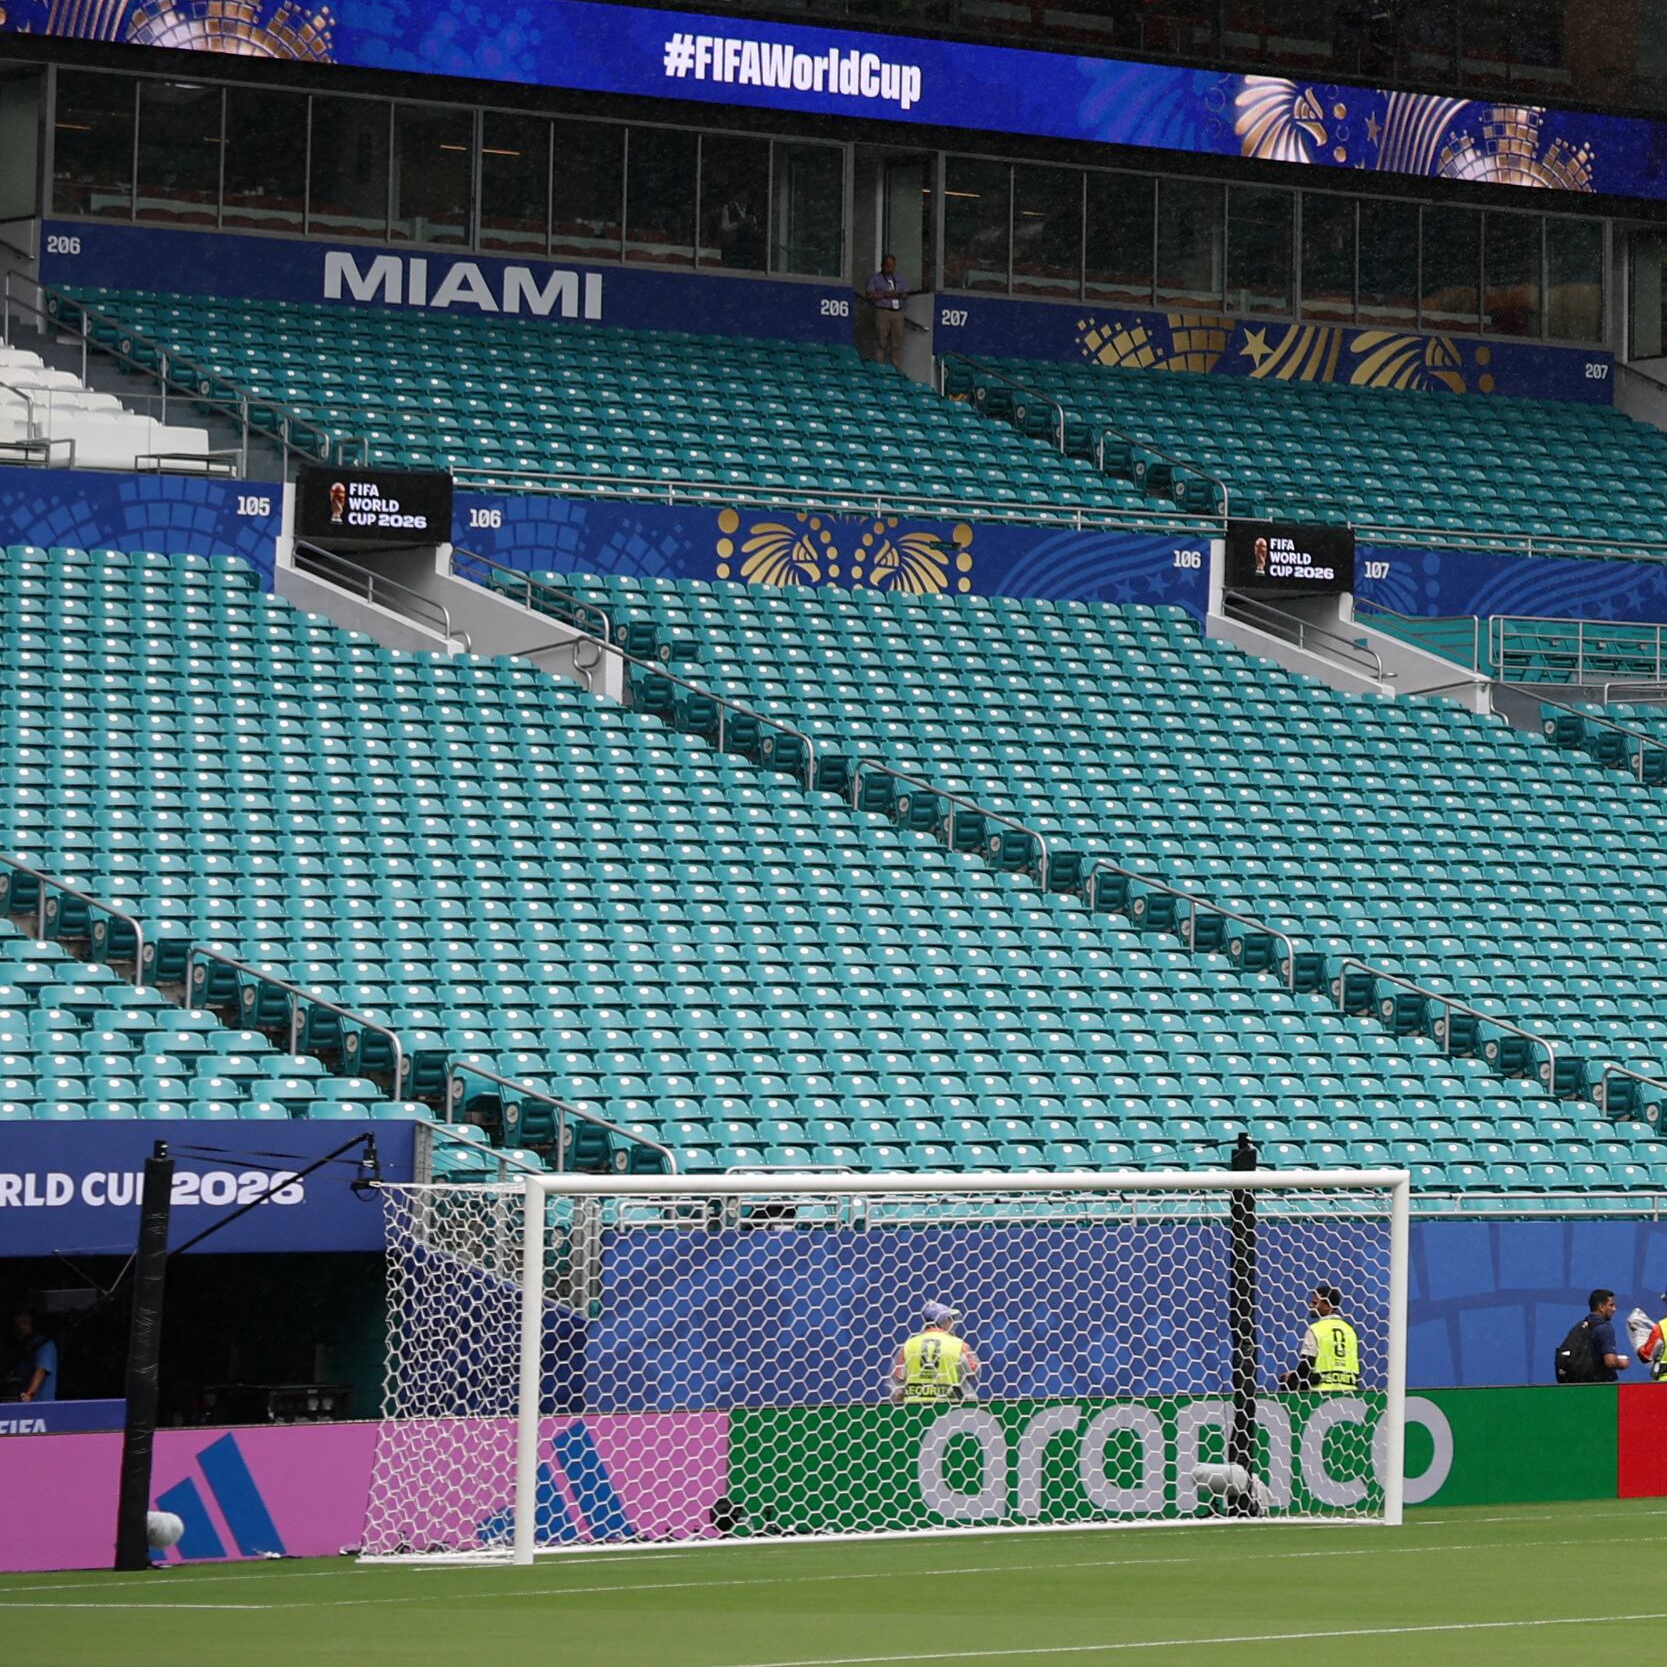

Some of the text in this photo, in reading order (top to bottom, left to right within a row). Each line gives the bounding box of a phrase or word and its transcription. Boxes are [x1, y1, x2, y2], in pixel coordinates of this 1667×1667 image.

[664, 33, 921, 109] #FIFAWorldCup
[47, 235, 81, 255] 206
[324, 252, 602, 319] MIAMI
[820, 298, 849, 318] 206
[941, 309, 968, 327] 207
[1585, 362, 1609, 380] 207
[349, 482, 380, 497] FIFA
[236, 495, 271, 517] 105
[349, 498, 400, 512] WORLD
[348, 512, 427, 529] CUP 2026
[469, 508, 502, 529] 106
[1269, 538, 1295, 551] FIFA
[1173, 549, 1202, 569] 106
[1269, 552, 1312, 565] WORLD
[1269, 565, 1335, 580] CUP 2026
[1364, 561, 1390, 579] 107
[81, 1172, 146, 1206] CU
[168, 1171, 304, 1205] 2026
[919, 1396, 1454, 1518] aramco
